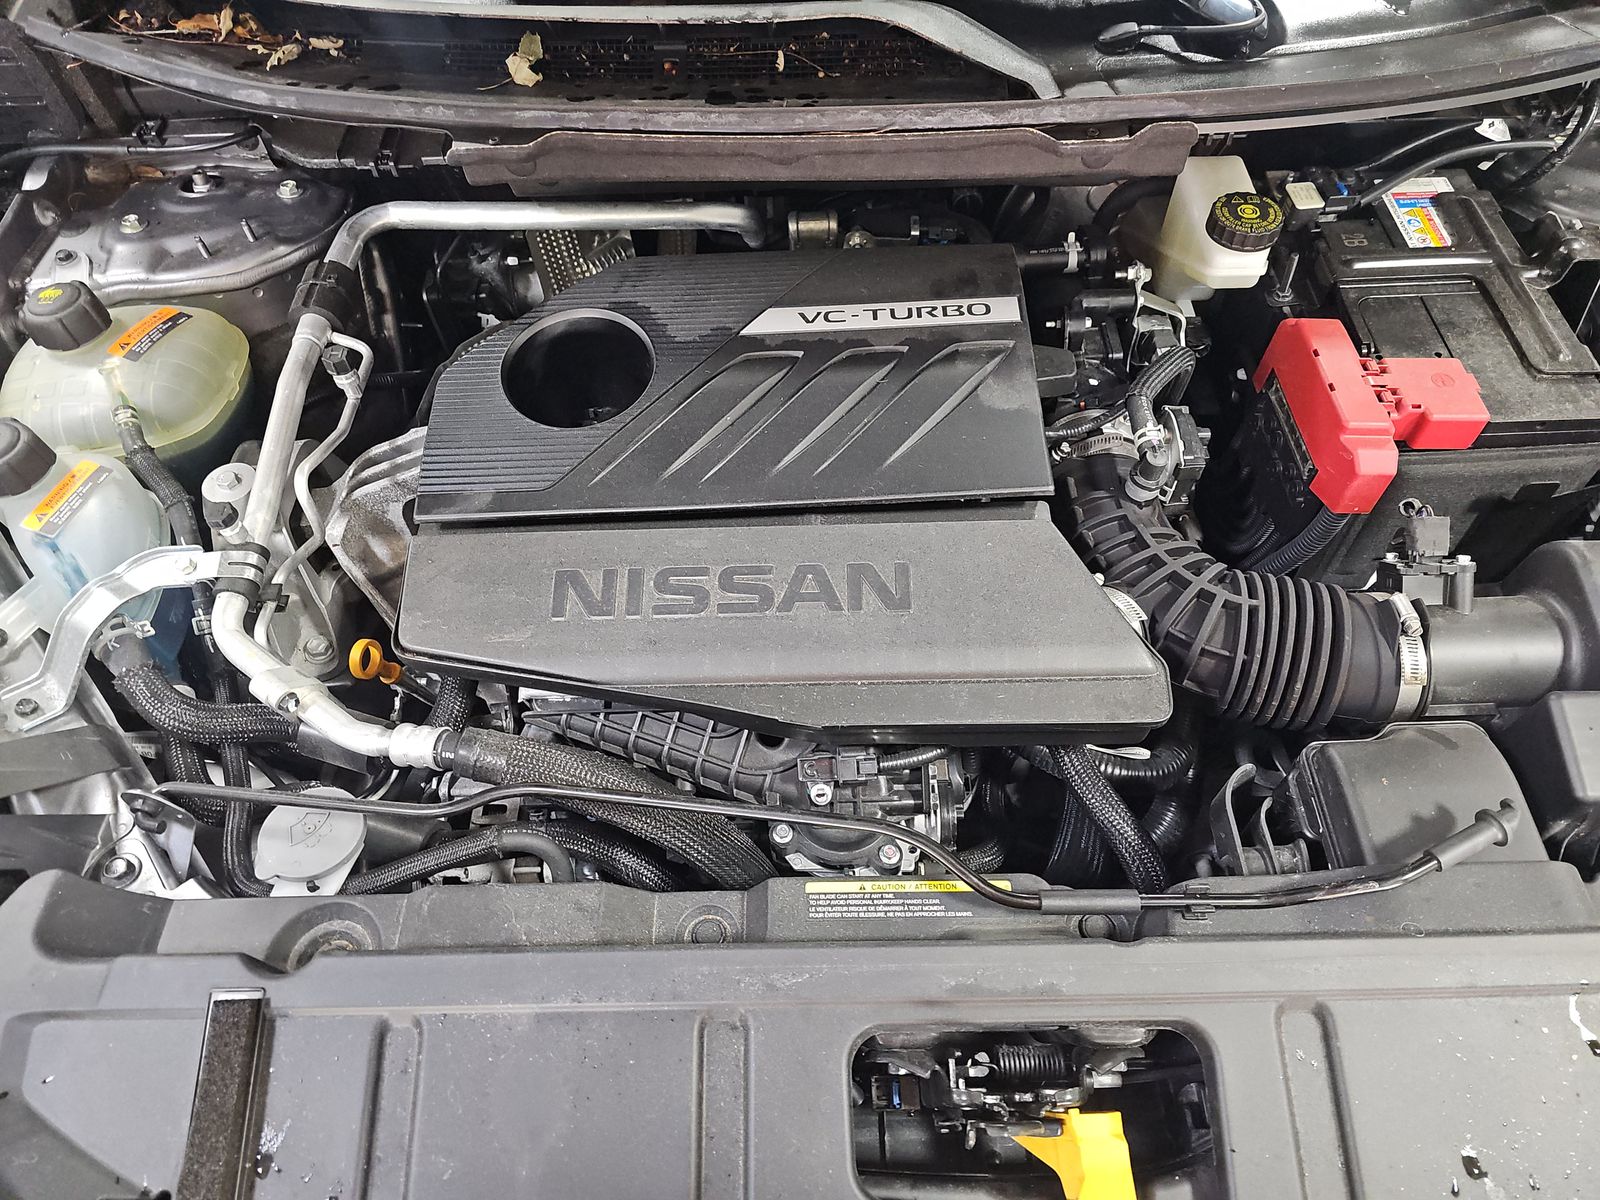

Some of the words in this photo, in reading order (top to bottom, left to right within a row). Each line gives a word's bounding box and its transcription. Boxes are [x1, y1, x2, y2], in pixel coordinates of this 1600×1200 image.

[798, 302, 992, 325] VC-TURBO
[551, 562, 913, 620] NISSAN
[441, 750, 454, 758] IN
